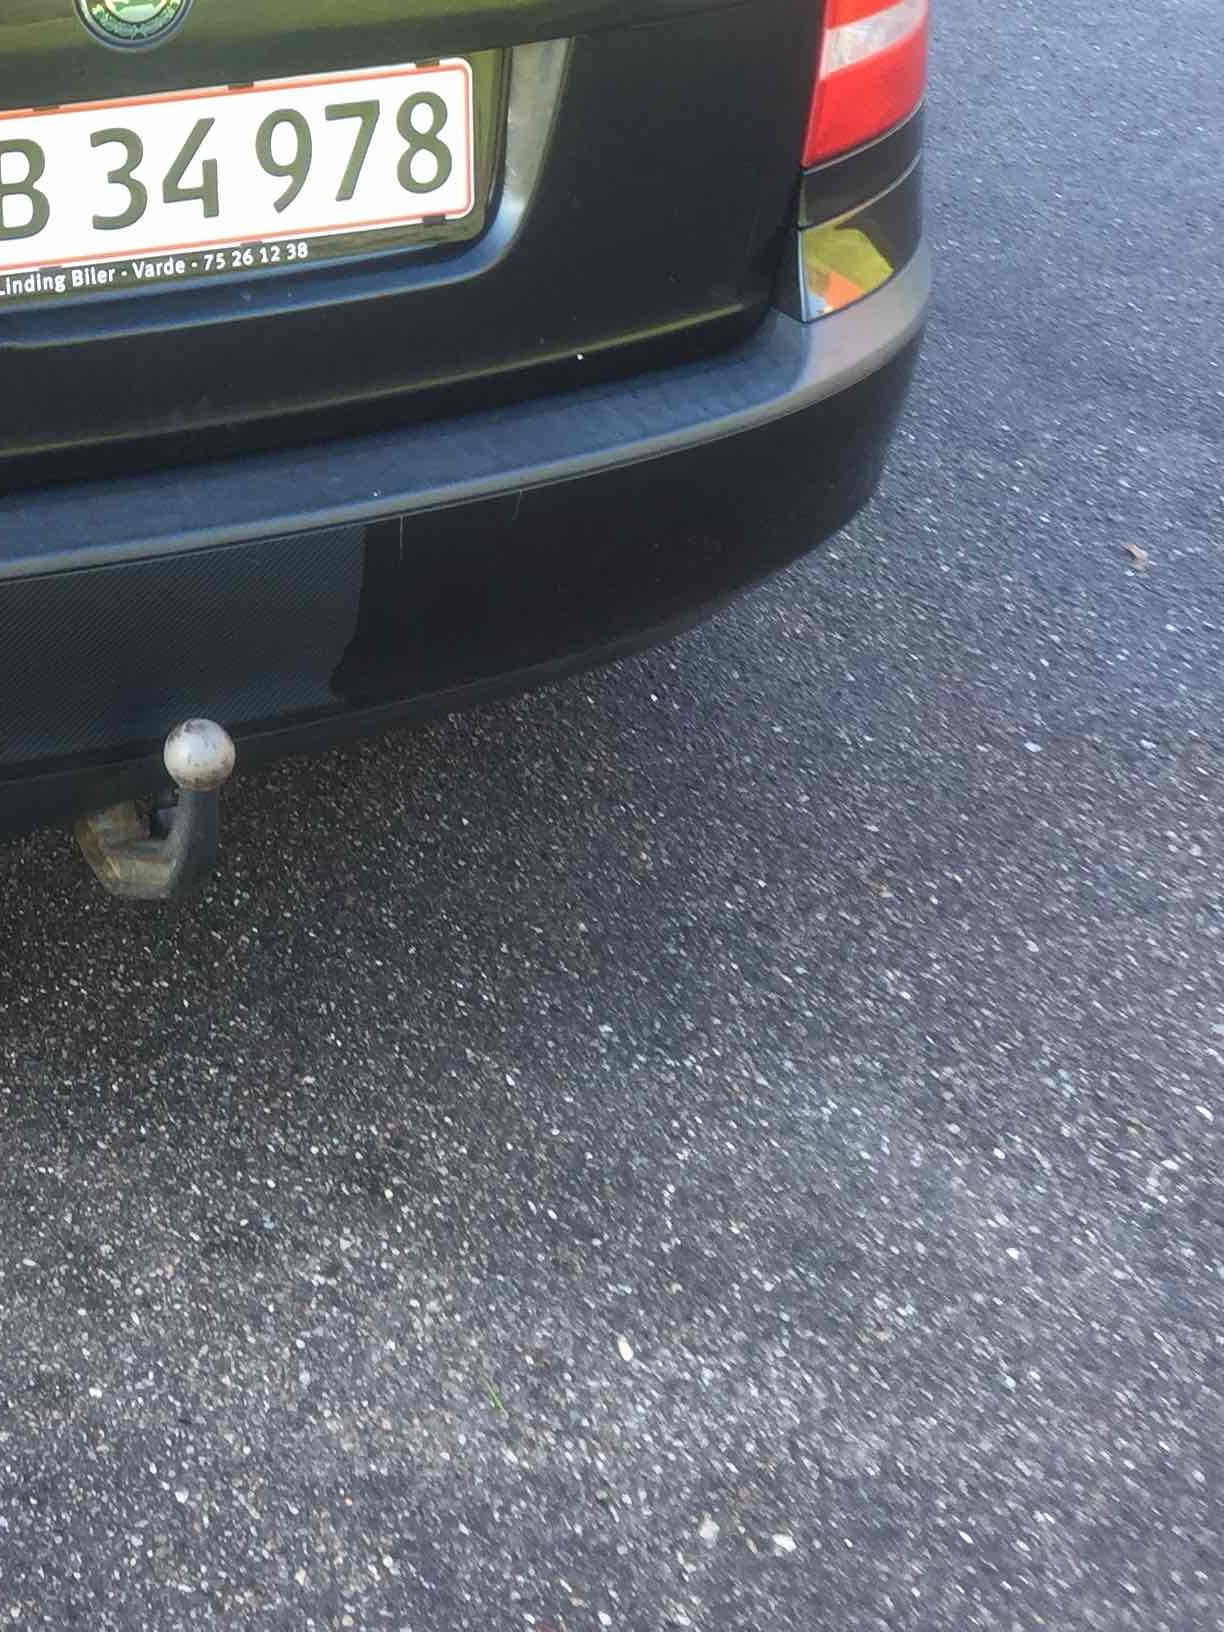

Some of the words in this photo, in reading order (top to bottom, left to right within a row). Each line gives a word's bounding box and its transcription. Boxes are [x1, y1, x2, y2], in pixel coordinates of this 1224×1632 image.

[89, 116, 221, 232] 34
[255, 90, 453, 215] 978
[71, 266, 116, 288] Biler
[131, 256, 186, 280] Varde
[203, 252, 226, 271] 75
[231, 248, 255, 267] 26
[259, 245, 281, 264] 12
[286, 241, 309, 260] 38
